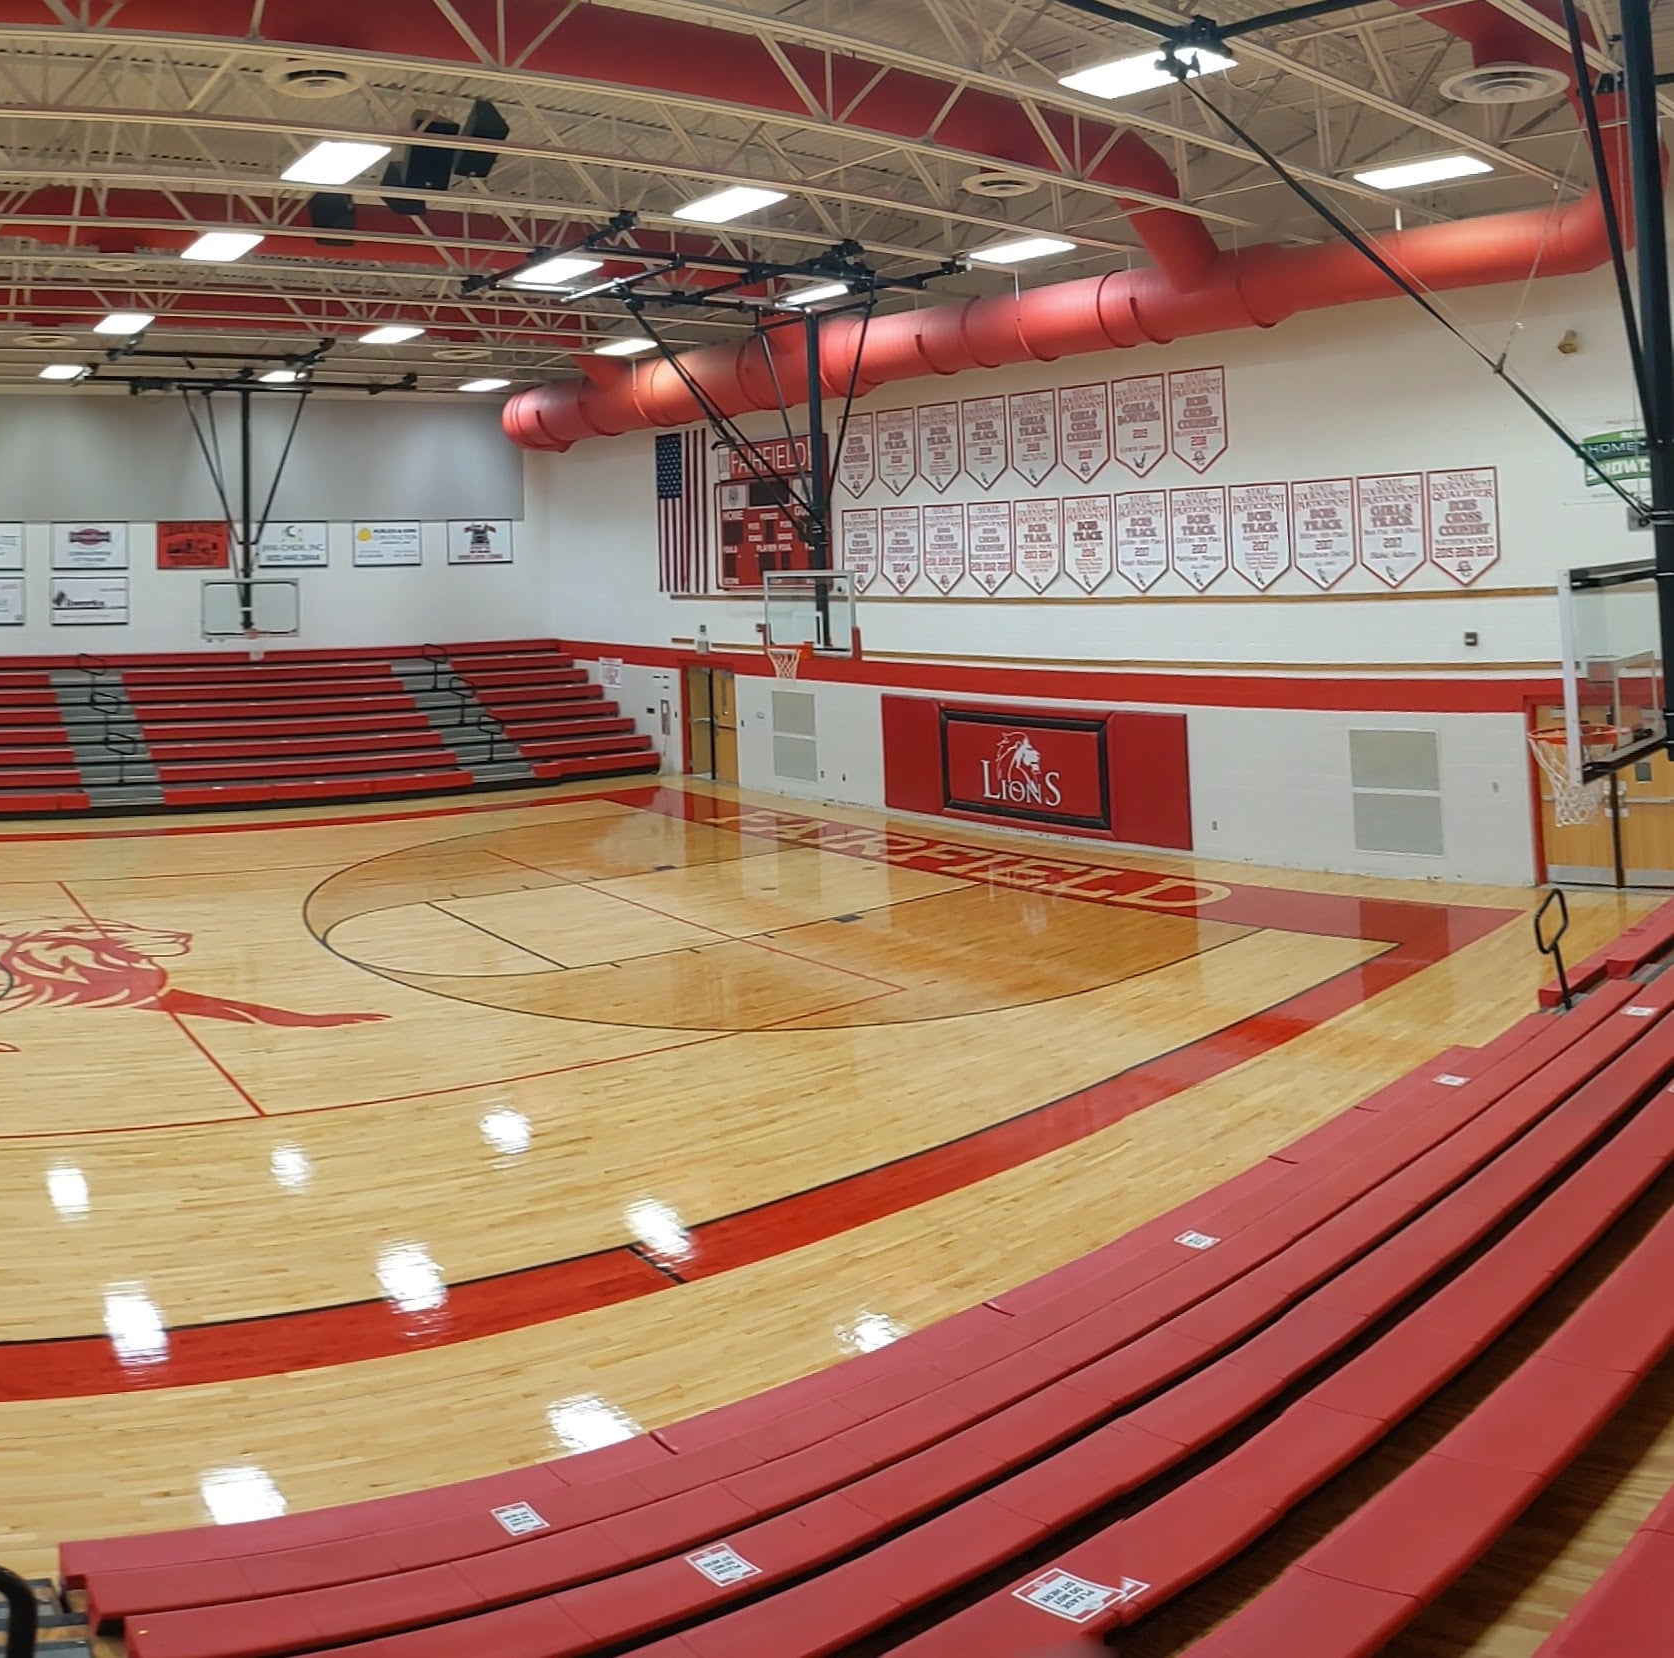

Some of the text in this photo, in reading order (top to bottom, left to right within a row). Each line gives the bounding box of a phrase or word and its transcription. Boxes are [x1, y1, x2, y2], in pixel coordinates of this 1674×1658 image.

[730, 442, 807, 473] FAIRFIELD
[980, 759, 1062, 807] LIONS
[707, 809, 1232, 907] FAIRFIELD
[1039, 1588, 1062, 1603] HERE
[1061, 1589, 1095, 1610] PLEASE
